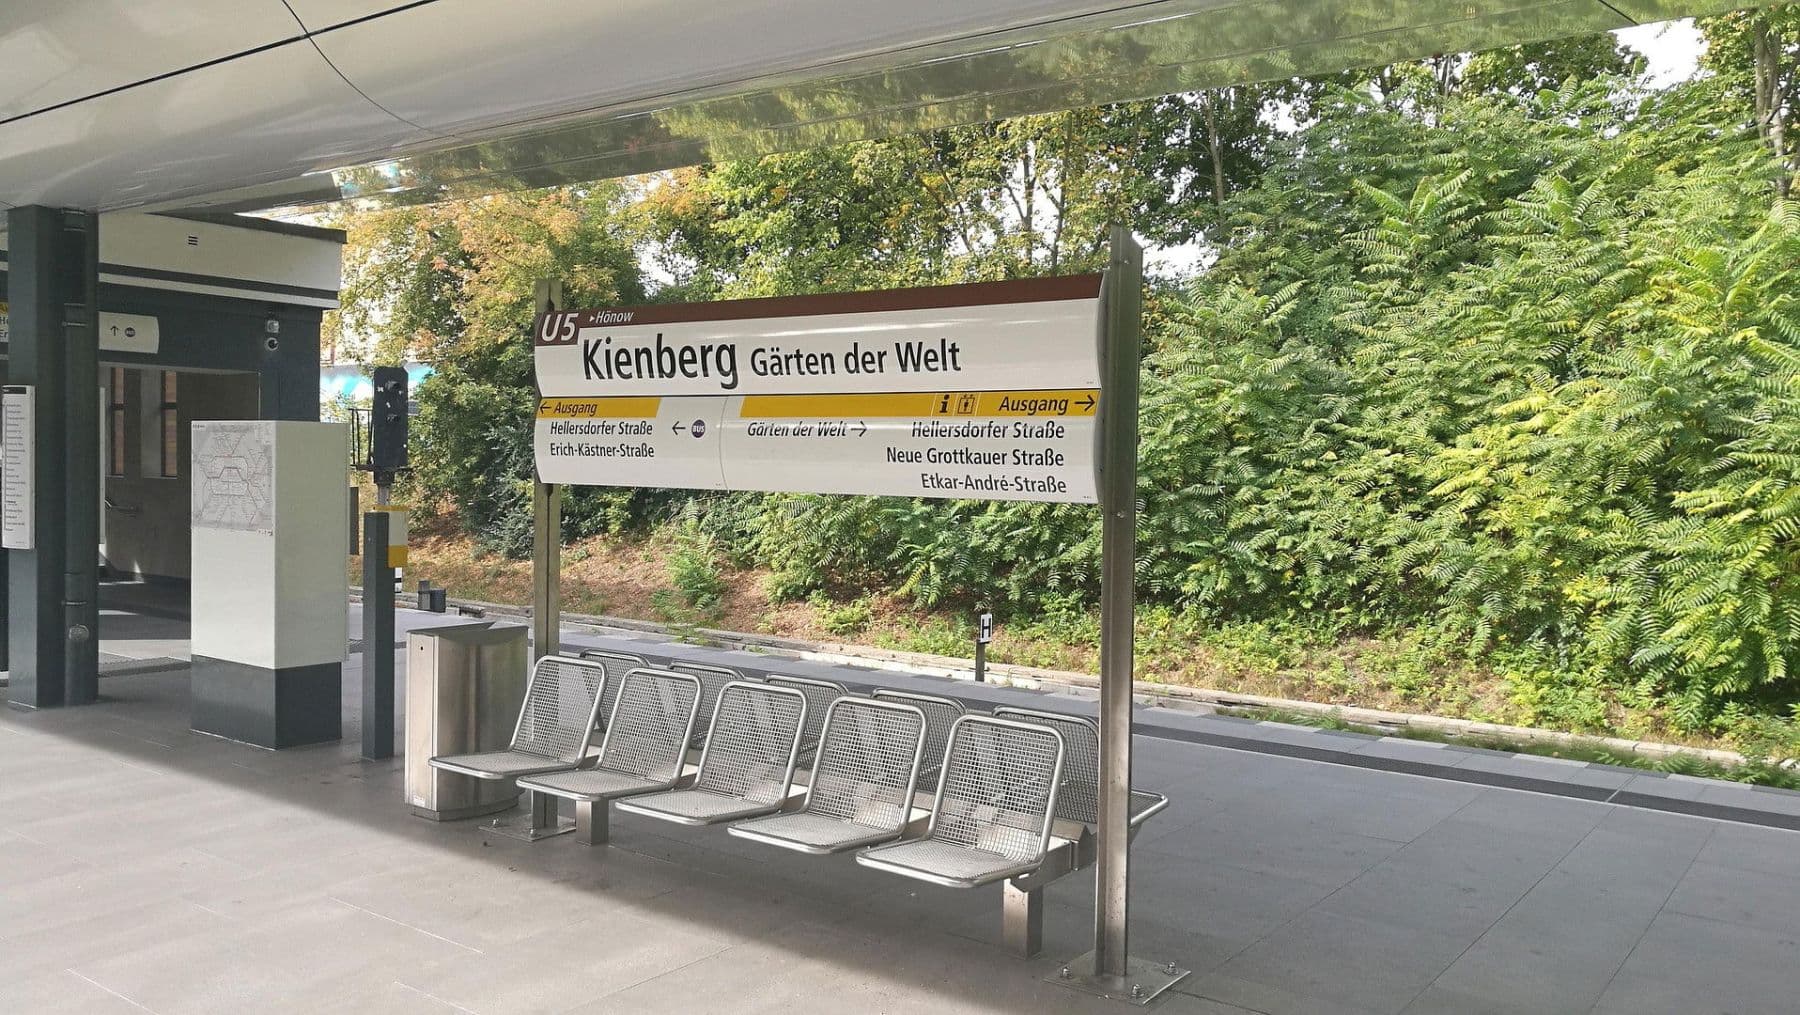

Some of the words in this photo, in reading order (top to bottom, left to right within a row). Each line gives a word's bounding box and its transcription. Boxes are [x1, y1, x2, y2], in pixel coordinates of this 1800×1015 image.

[595, 311, 633, 324] Hönow
[541, 313, 578, 342] U5
[583, 333, 739, 390] Kienberg
[751, 346, 835, 377] Gärten
[844, 342, 887, 375] der
[895, 338, 961, 373] Welt
[554, 402, 597, 416] Ausgang
[999, 397, 1068, 415] Ausgang
[550, 420, 615, 435] Hellersdorfer
[618, 420, 653, 435] Straße
[692, 425, 705, 433] BUS
[748, 421, 789, 437] Gärten
[792, 421, 814, 437] der
[817, 421, 847, 437] Welt
[912, 421, 1008, 438] Hellersdorfer
[1013, 421, 1065, 439] Straße
[550, 442, 655, 457] Erich-Kästner-Straße
[886, 447, 922, 463] Neue
[927, 447, 1007, 465] Grottkauer
[1013, 449, 1064, 466] Straße
[921, 473, 1067, 493] Etkar-André-Straße
[982, 618, 991, 638] H
